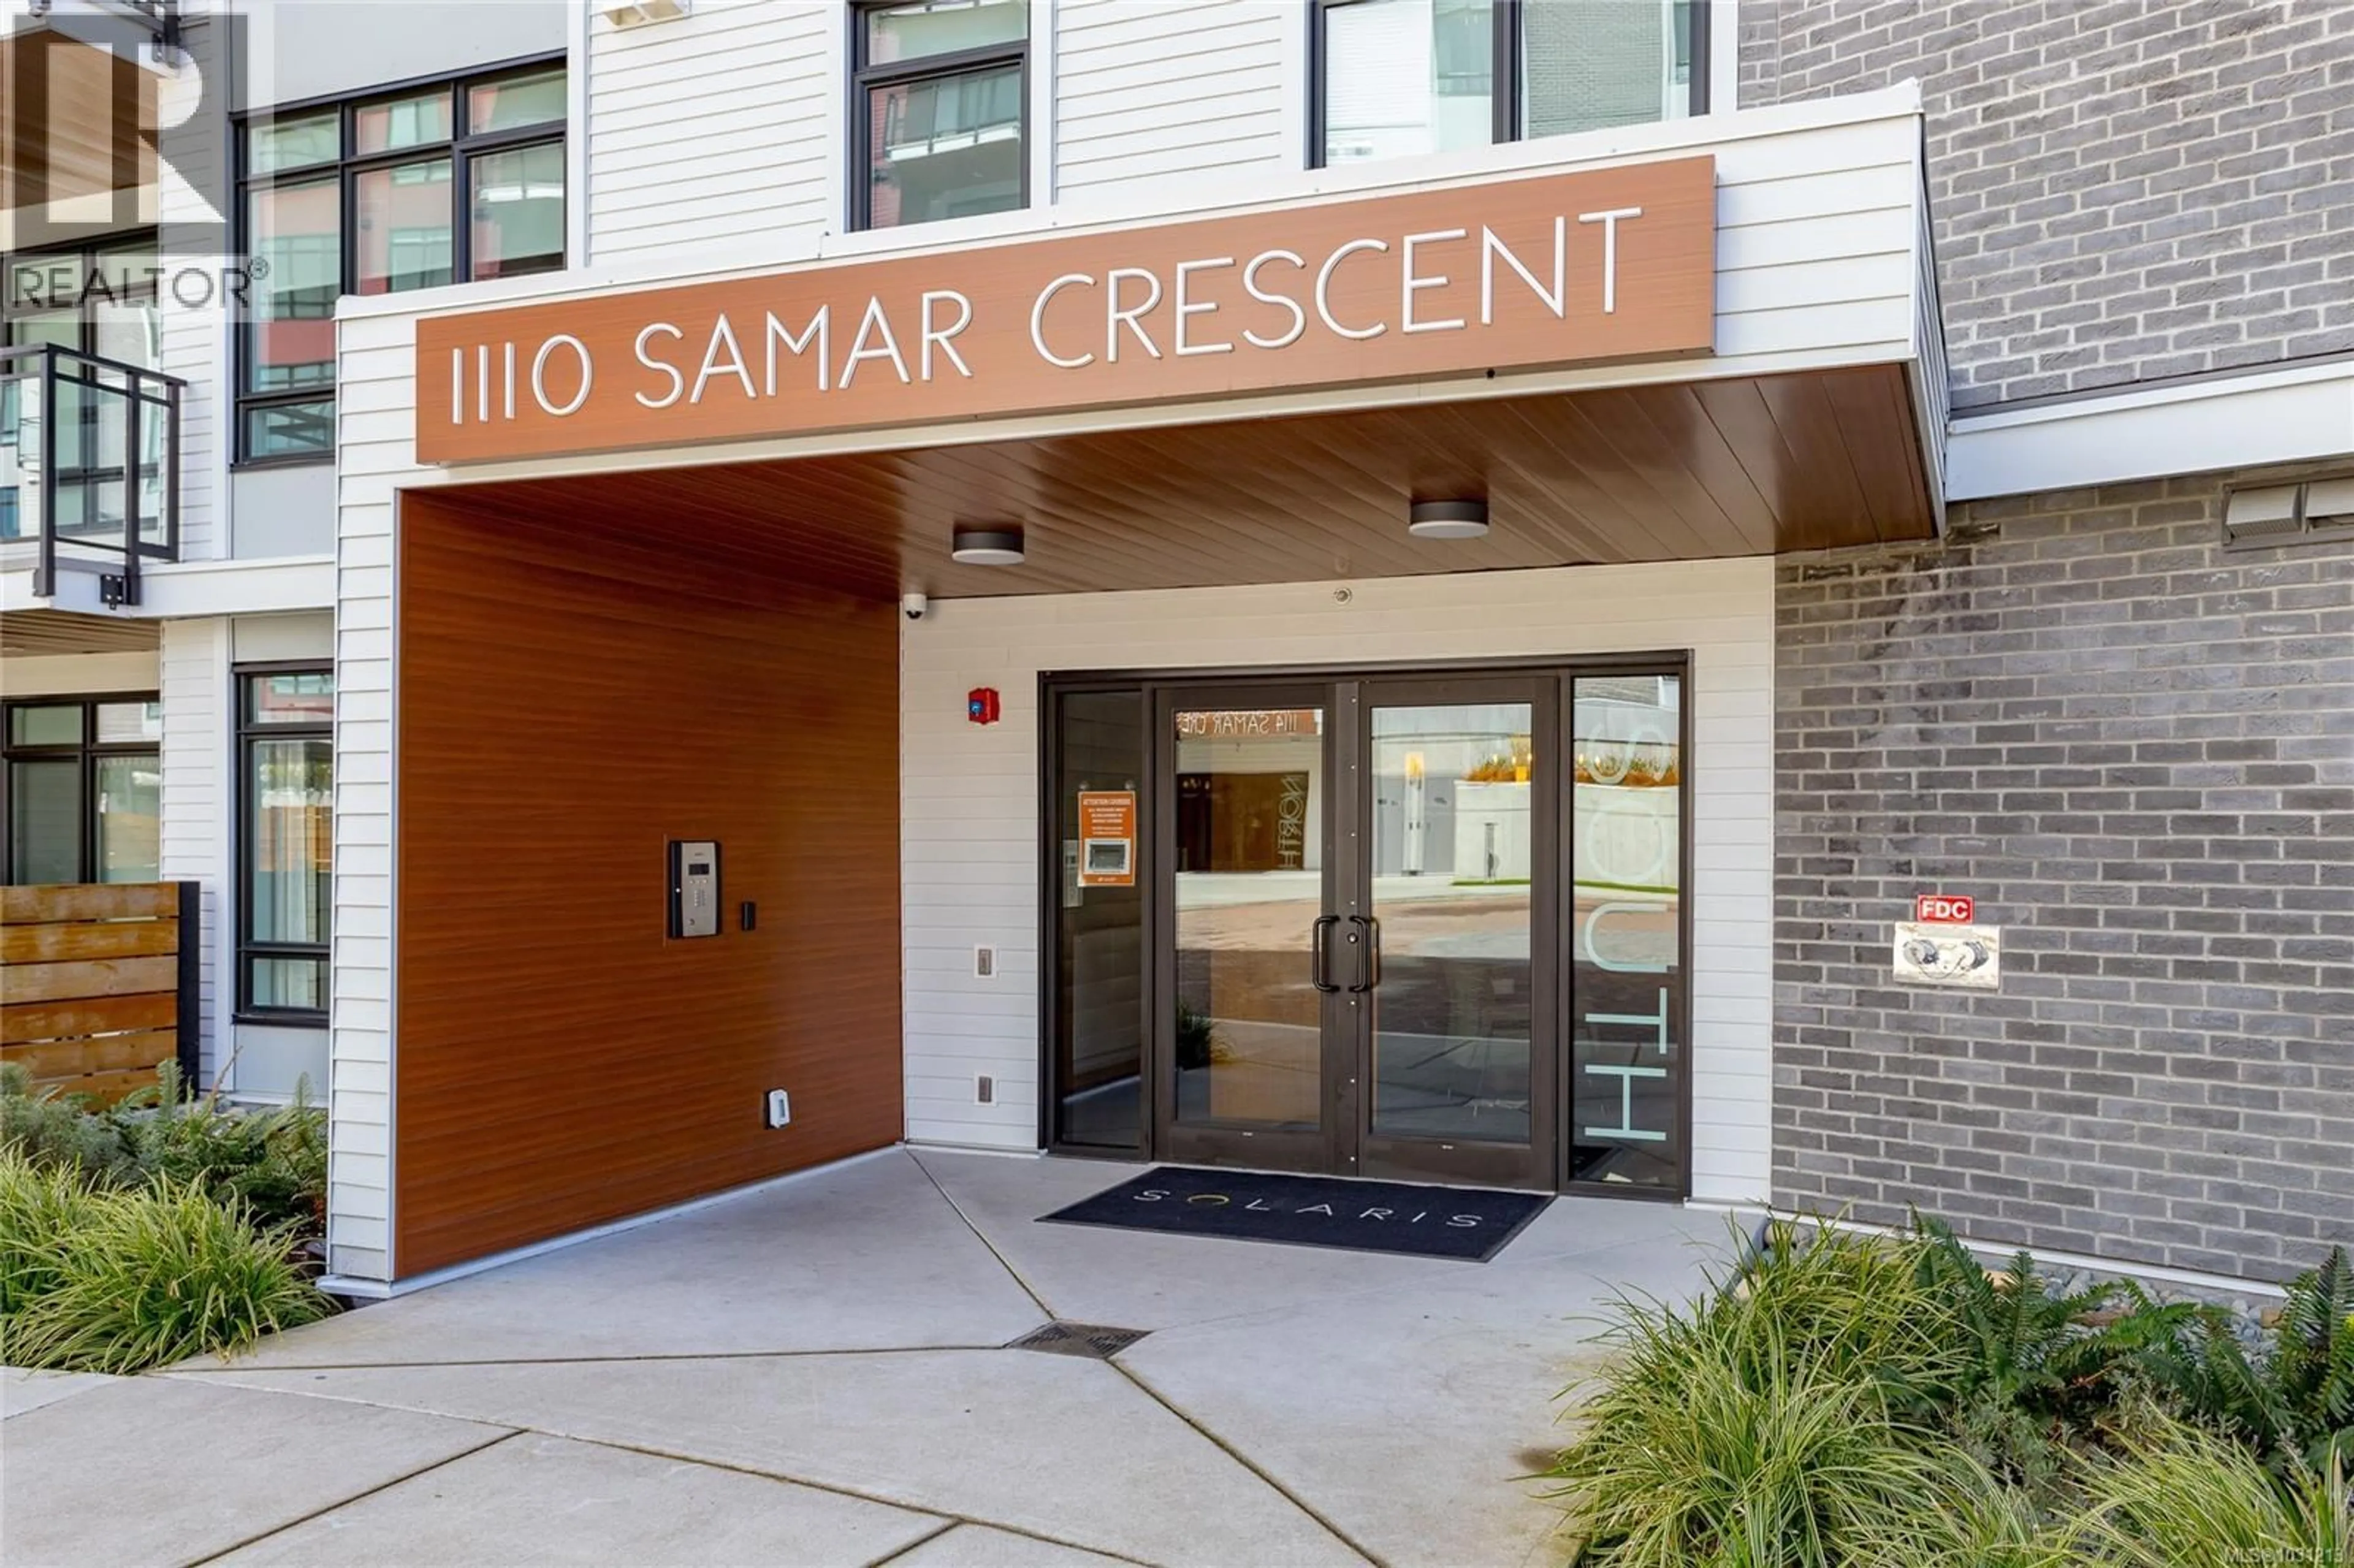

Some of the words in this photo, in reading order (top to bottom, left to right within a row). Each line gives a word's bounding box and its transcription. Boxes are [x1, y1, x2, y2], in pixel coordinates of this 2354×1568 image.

[452, 333, 593, 424] 1110
[634, 289, 973, 408] SAMAR
[1029, 206, 1642, 368] CRESCENT
[1585, 721, 1669, 1141] SOUTH
[1922, 900, 1968, 919] FDC
[1133, 1189, 1483, 1227] SOLARIS
